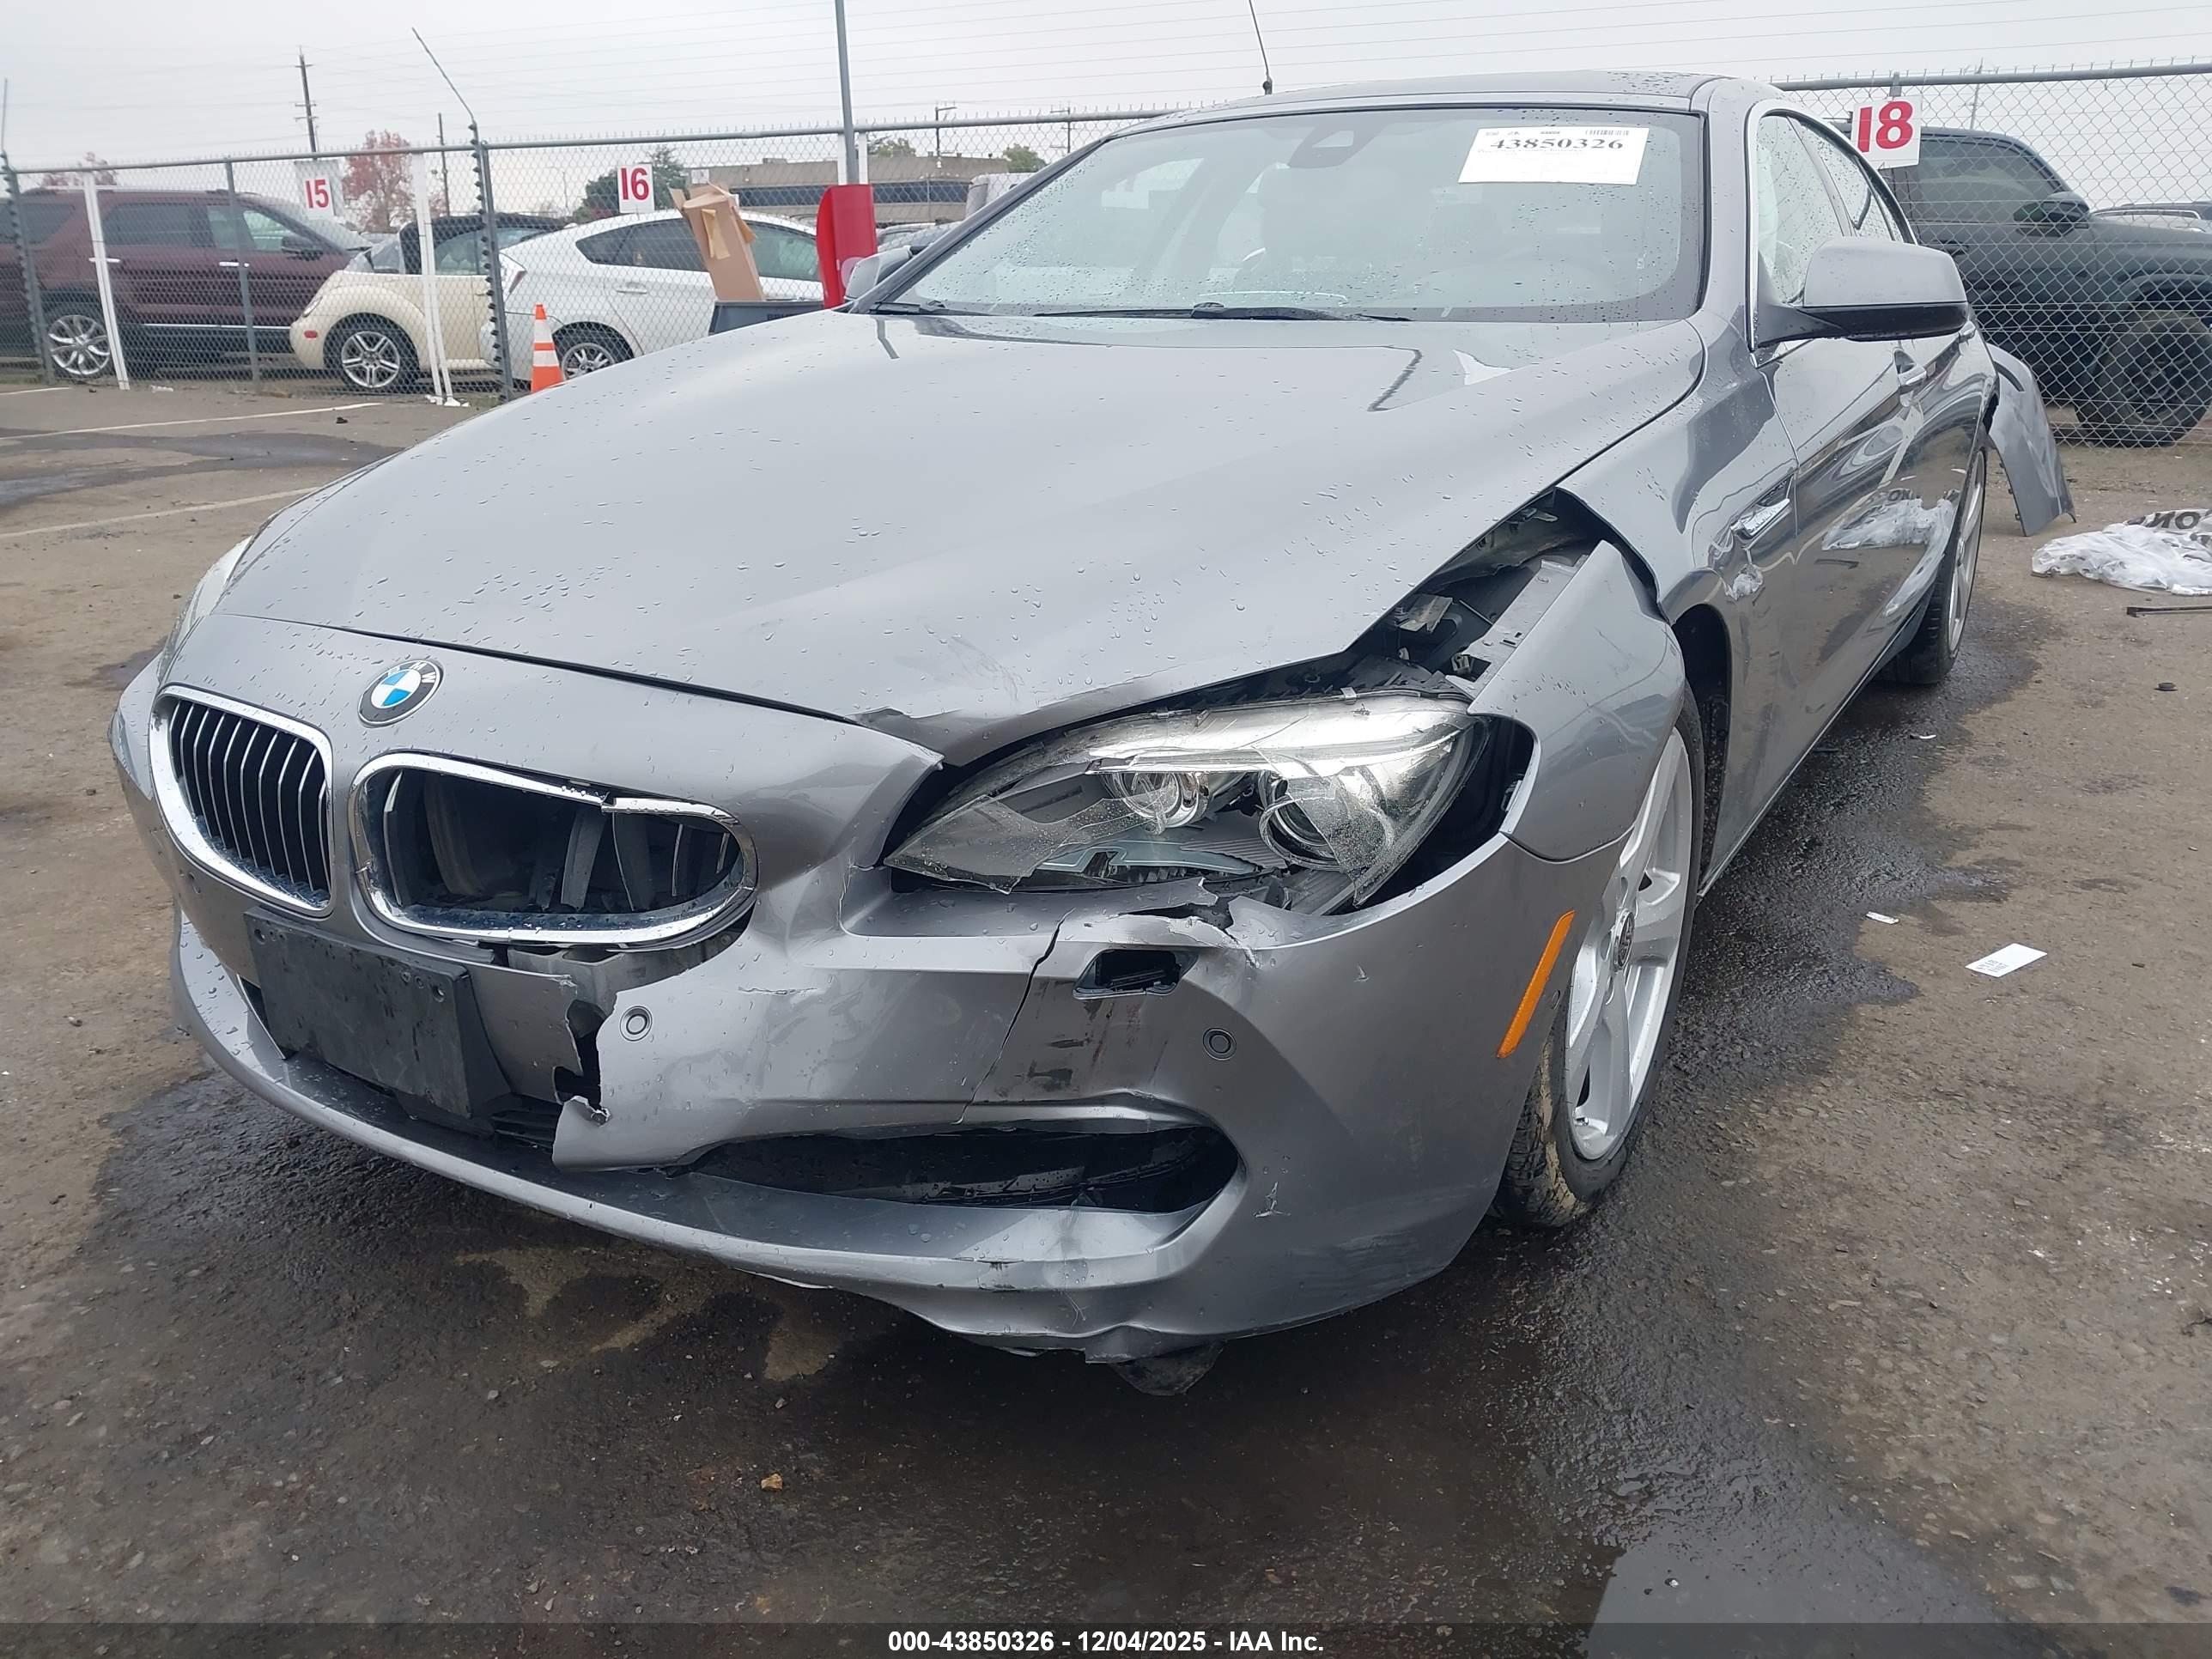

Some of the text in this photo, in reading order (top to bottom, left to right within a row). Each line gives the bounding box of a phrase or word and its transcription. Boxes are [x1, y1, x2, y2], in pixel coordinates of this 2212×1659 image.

[1857, 100, 1913, 153] 18
[1490, 138, 1624, 150] 43850326
[305, 179, 329, 208] 15
[621, 167, 649, 200] 16
